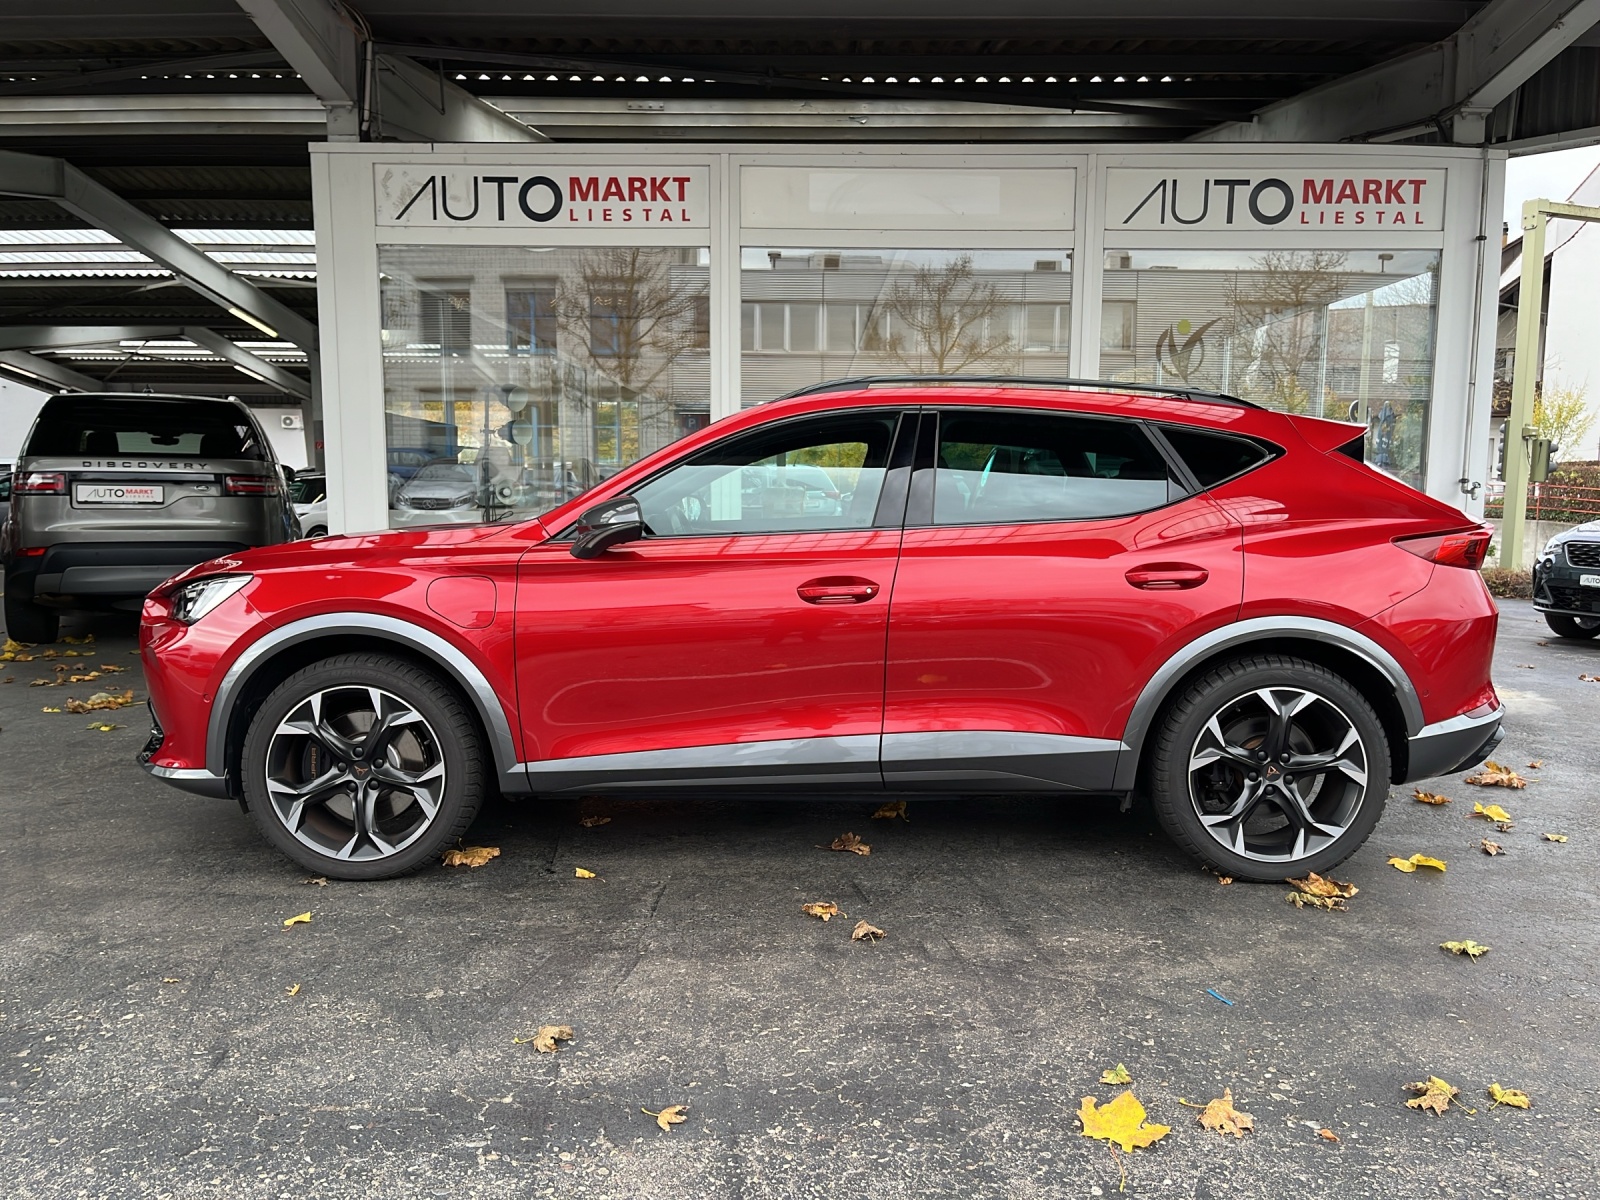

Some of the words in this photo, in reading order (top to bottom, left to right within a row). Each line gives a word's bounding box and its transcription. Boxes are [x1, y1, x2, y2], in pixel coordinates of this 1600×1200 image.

[395, 175, 563, 222] AUTO
[569, 177, 690, 202] MARKT
[1122, 178, 1294, 225] AUTO
[1302, 179, 1427, 204] MARKT
[569, 208, 691, 222] LIESTAL
[1300, 211, 1424, 225] LIESTAL
[82, 461, 208, 469] DISCOVERY
[87, 489, 125, 498] AUTO
